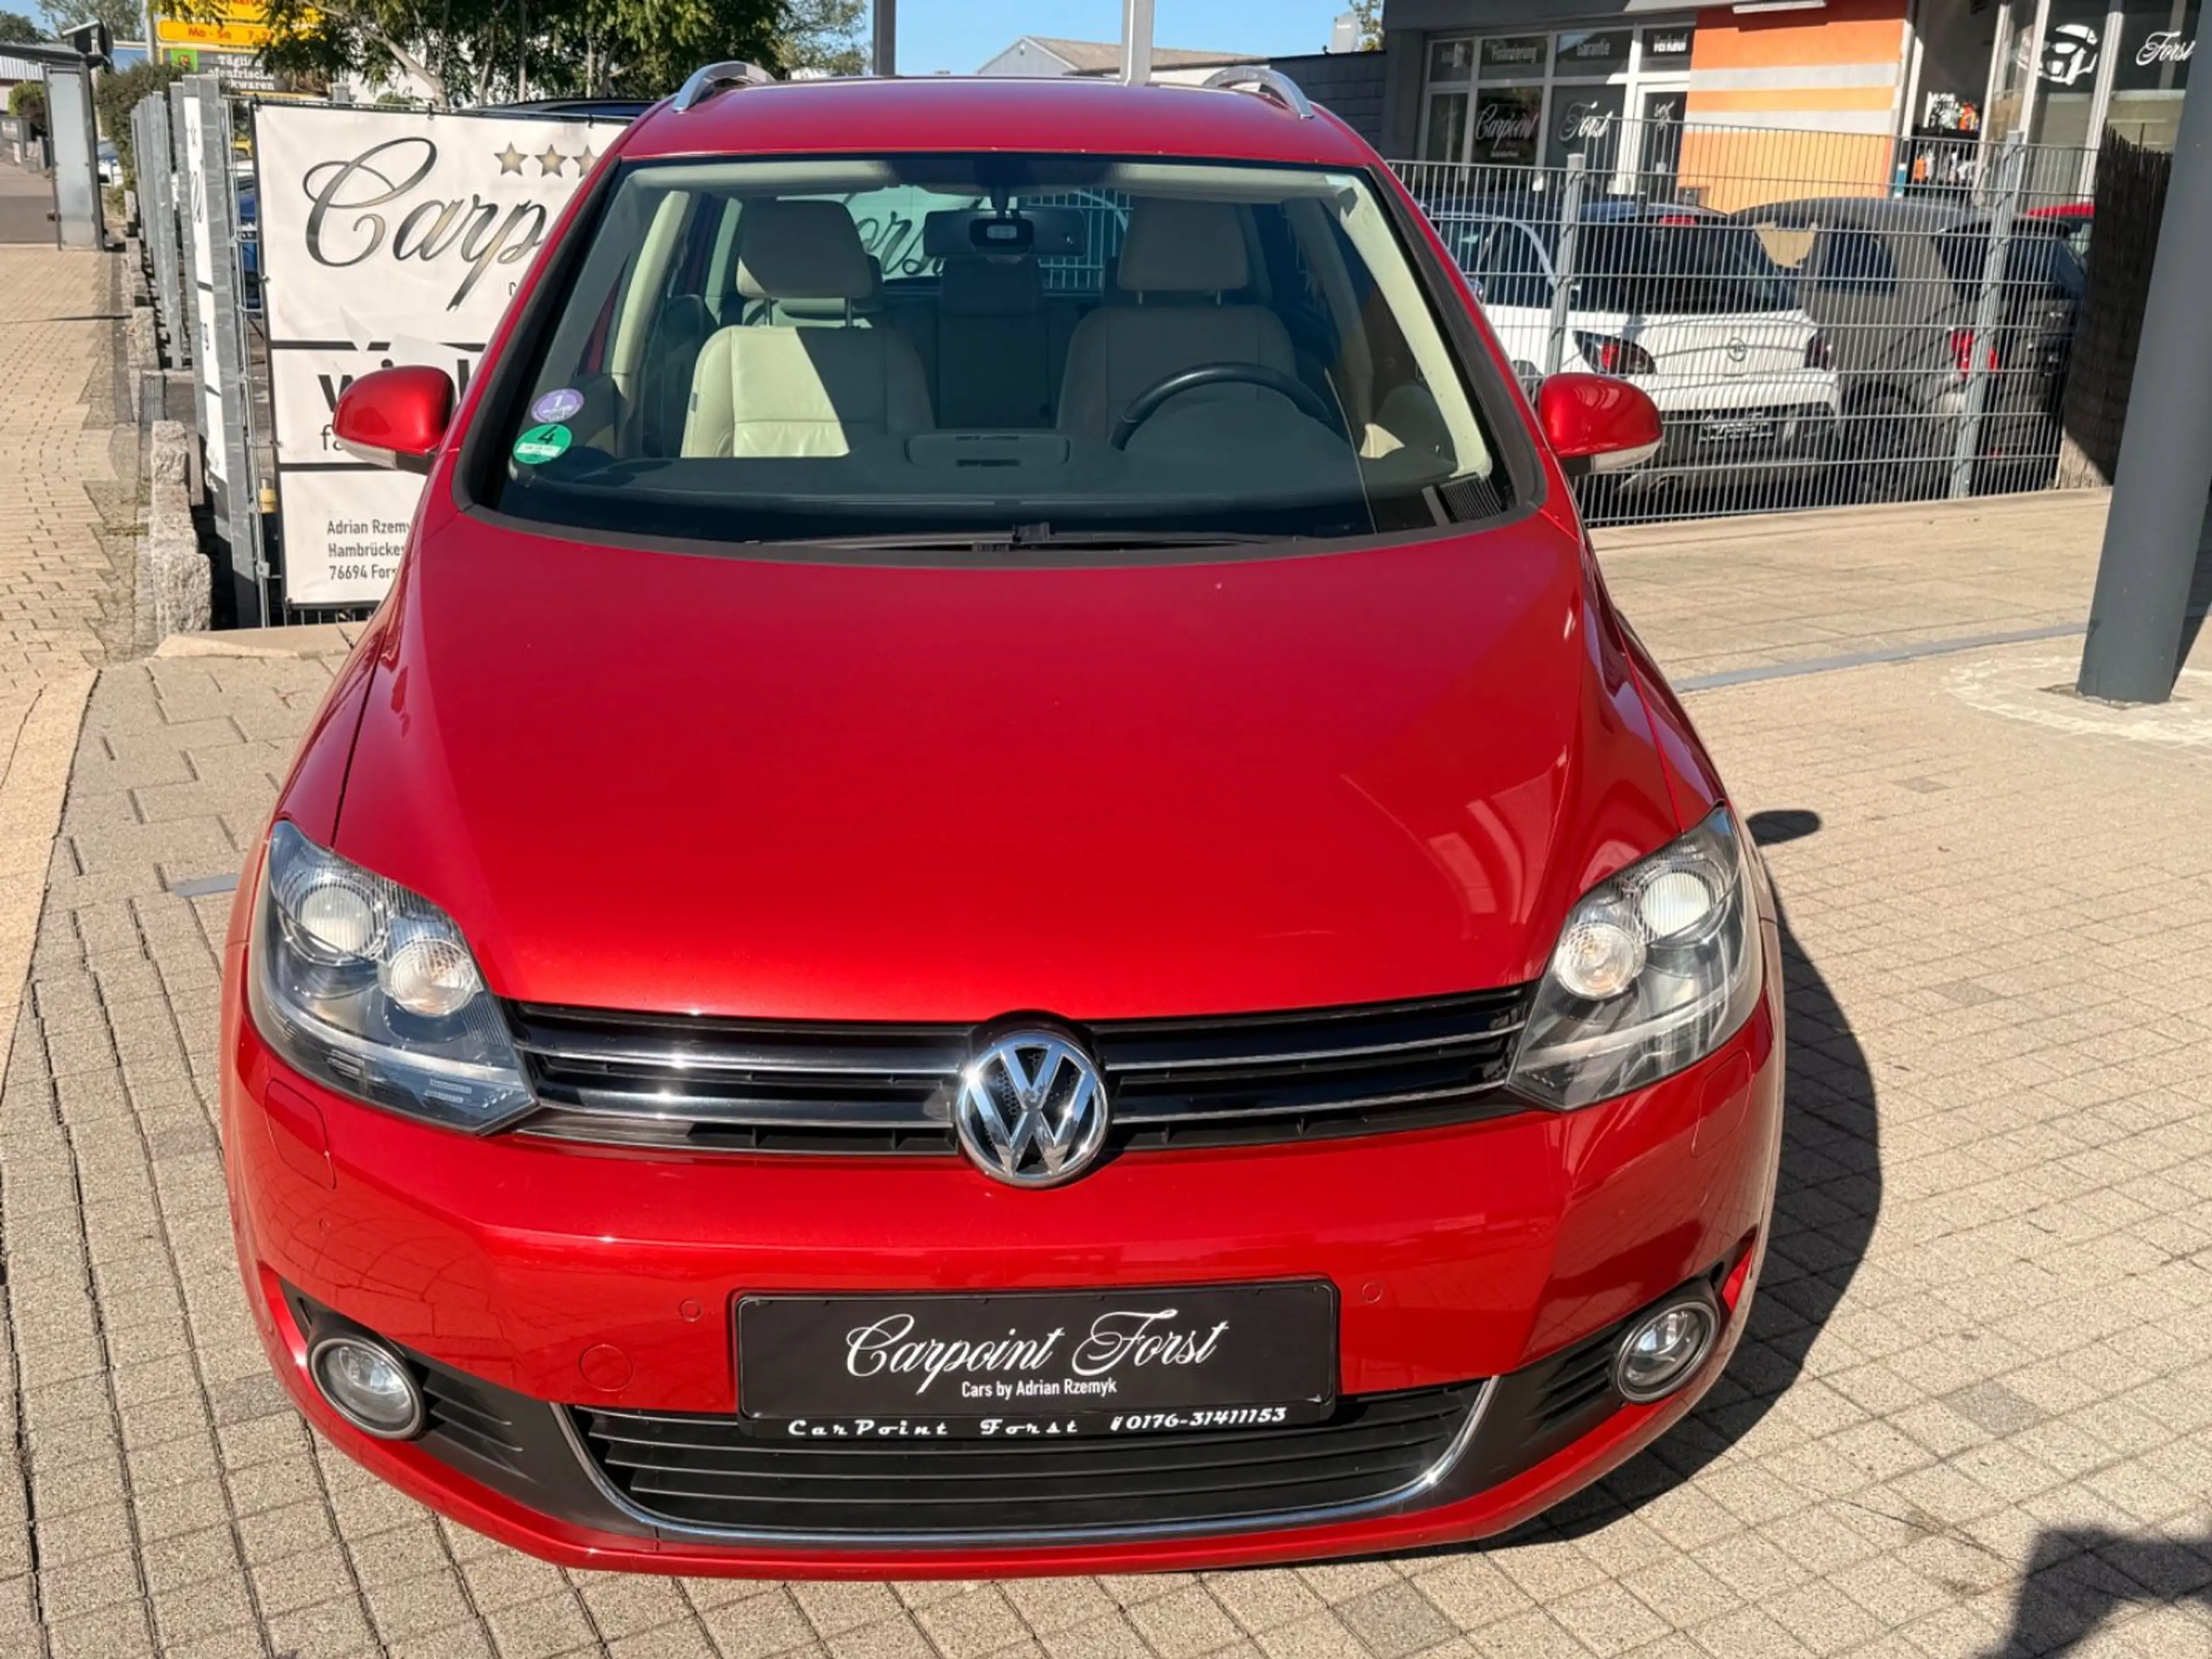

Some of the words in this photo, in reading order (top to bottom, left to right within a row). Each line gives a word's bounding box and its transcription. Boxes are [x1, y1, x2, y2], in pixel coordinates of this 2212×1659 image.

[537, 426, 558, 444] 4
[327, 520, 369, 535] Adrian
[329, 565, 368, 580] 76694
[846, 1313, 1066, 1395] Carpoint
[1071, 1309, 1230, 1376] Forst
[961, 1381, 993, 1397] Cars
[997, 1381, 1013, 1400] by
[1016, 1379, 1060, 1396] Adrian
[1063, 1377, 1118, 1397] Rzemyk
[980, 1418, 1078, 1435] Forst
[1125, 1407, 1288, 1430] 0176-31411153
